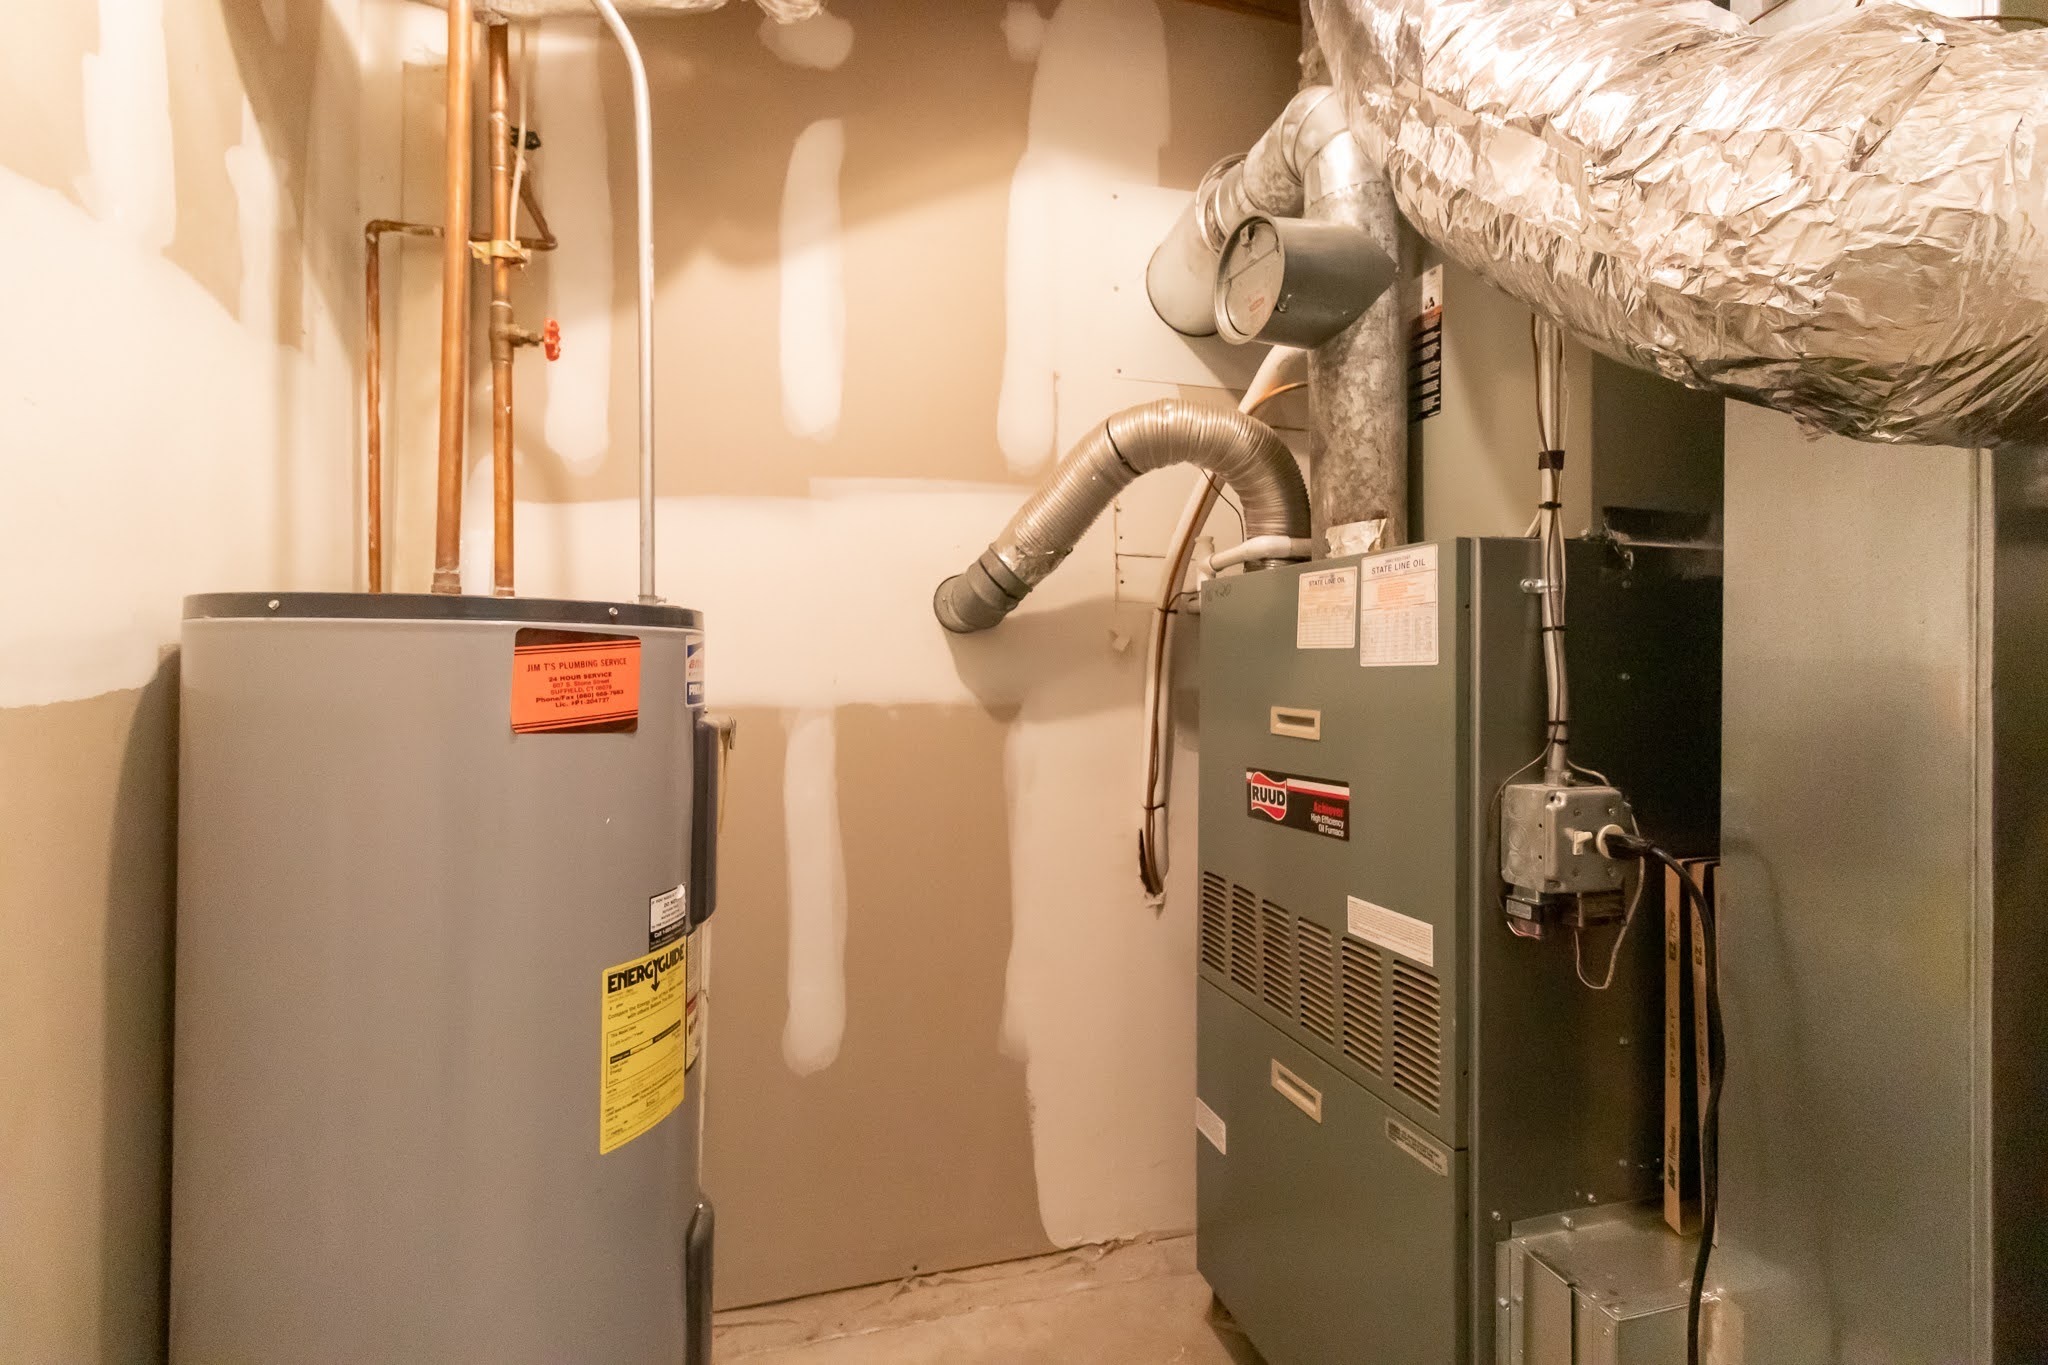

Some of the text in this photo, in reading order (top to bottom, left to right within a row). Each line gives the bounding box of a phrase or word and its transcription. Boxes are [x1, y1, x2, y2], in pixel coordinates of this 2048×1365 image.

[1371, 564, 1392, 575] STATE
[1394, 560, 1411, 571] LINE
[1412, 558, 1426, 568] OIL
[1308, 579, 1323, 587] STATE
[1324, 577, 1336, 585] LINE
[1337, 576, 1345, 584] OIL
[527, 657, 627, 672] JIM T'S PLUMBING SERVICE
[583, 672, 612, 680] SERVICE
[592, 678, 610, 686] Street
[535, 694, 574, 703] Phone/Fax
[1252, 786, 1286, 806] RUUD
[1310, 813, 1345, 829] High Efficiency
[1325, 825, 1345, 837] Furnace
[608, 943, 685, 994] ENERGYGUIDE
[637, 1000, 650, 1010] Energy
